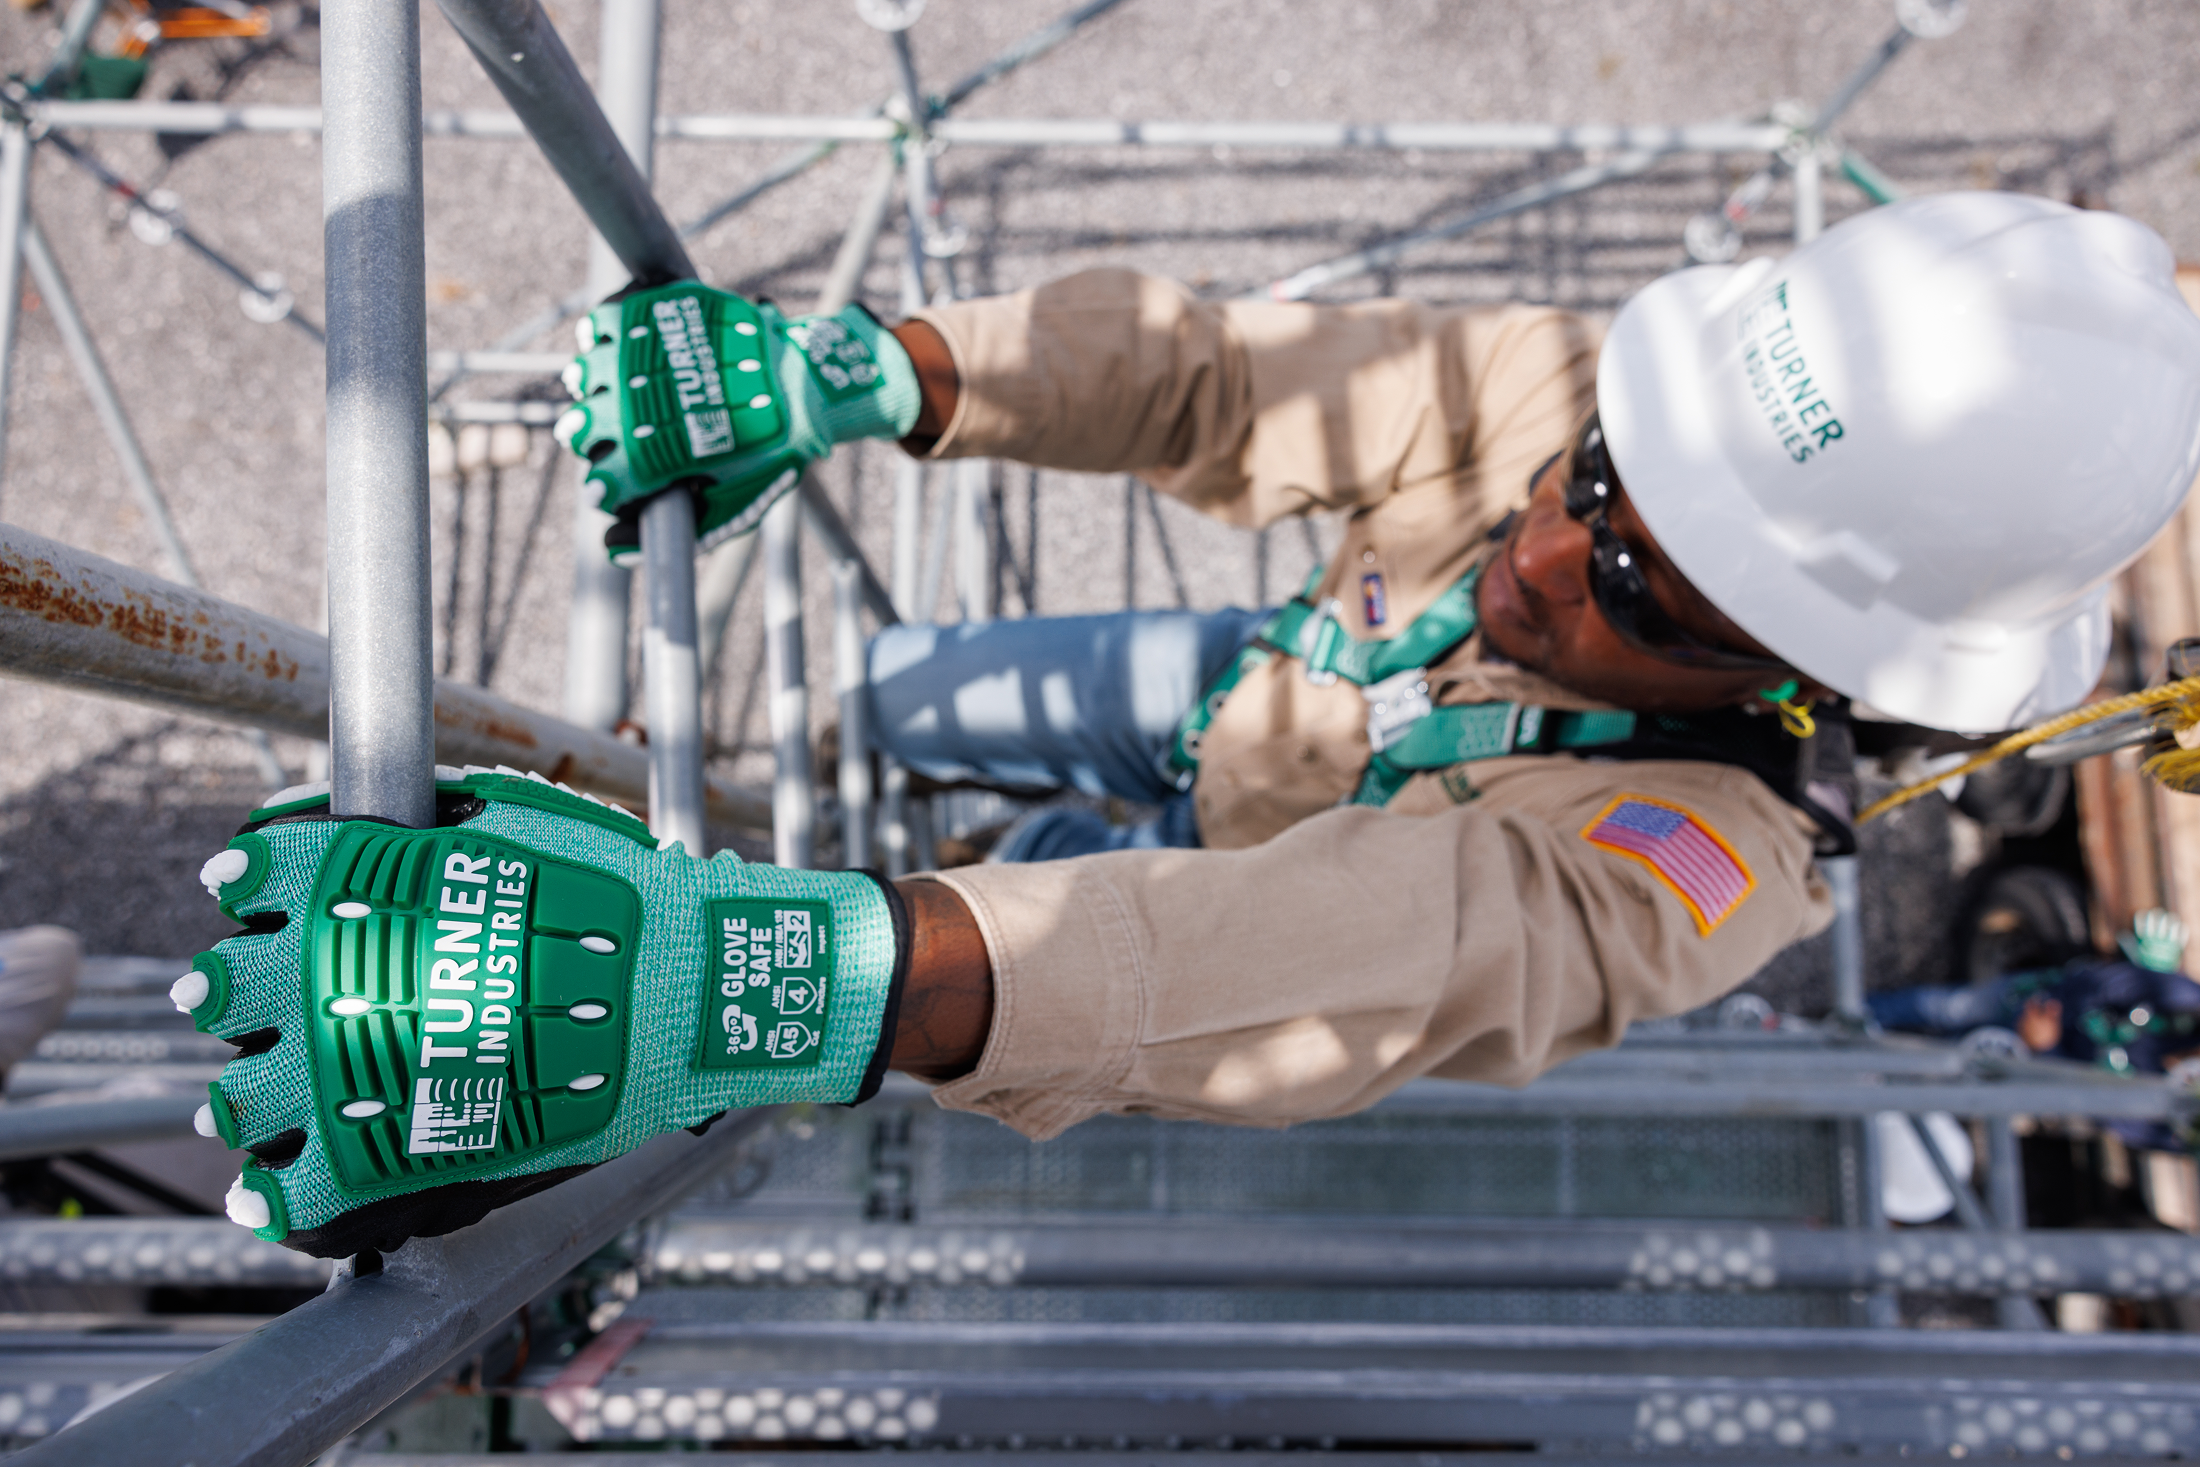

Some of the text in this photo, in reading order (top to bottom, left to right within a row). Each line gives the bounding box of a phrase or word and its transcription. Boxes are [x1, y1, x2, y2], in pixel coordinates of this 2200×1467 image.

[653, 300, 705, 411] TURNER
[1744, 340, 1814, 464] INDUSTRIES
[1766, 318, 1844, 449] TURNER
[790, 914, 804, 927] 2
[818, 925, 827, 954] Impact
[420, 852, 491, 1068] TURNER
[475, 859, 528, 1064] INDUSTRIES
[720, 917, 748, 997] GLOVE
[748, 927, 773, 988] SAFE
[771, 985, 781, 1009] ANSI
[787, 986, 809, 1005] 4
[815, 976, 827, 1015] Puncture
[764, 1030, 777, 1052] ANSI
[780, 1027, 799, 1053] A5
[810, 1030, 821, 1047] Cut
